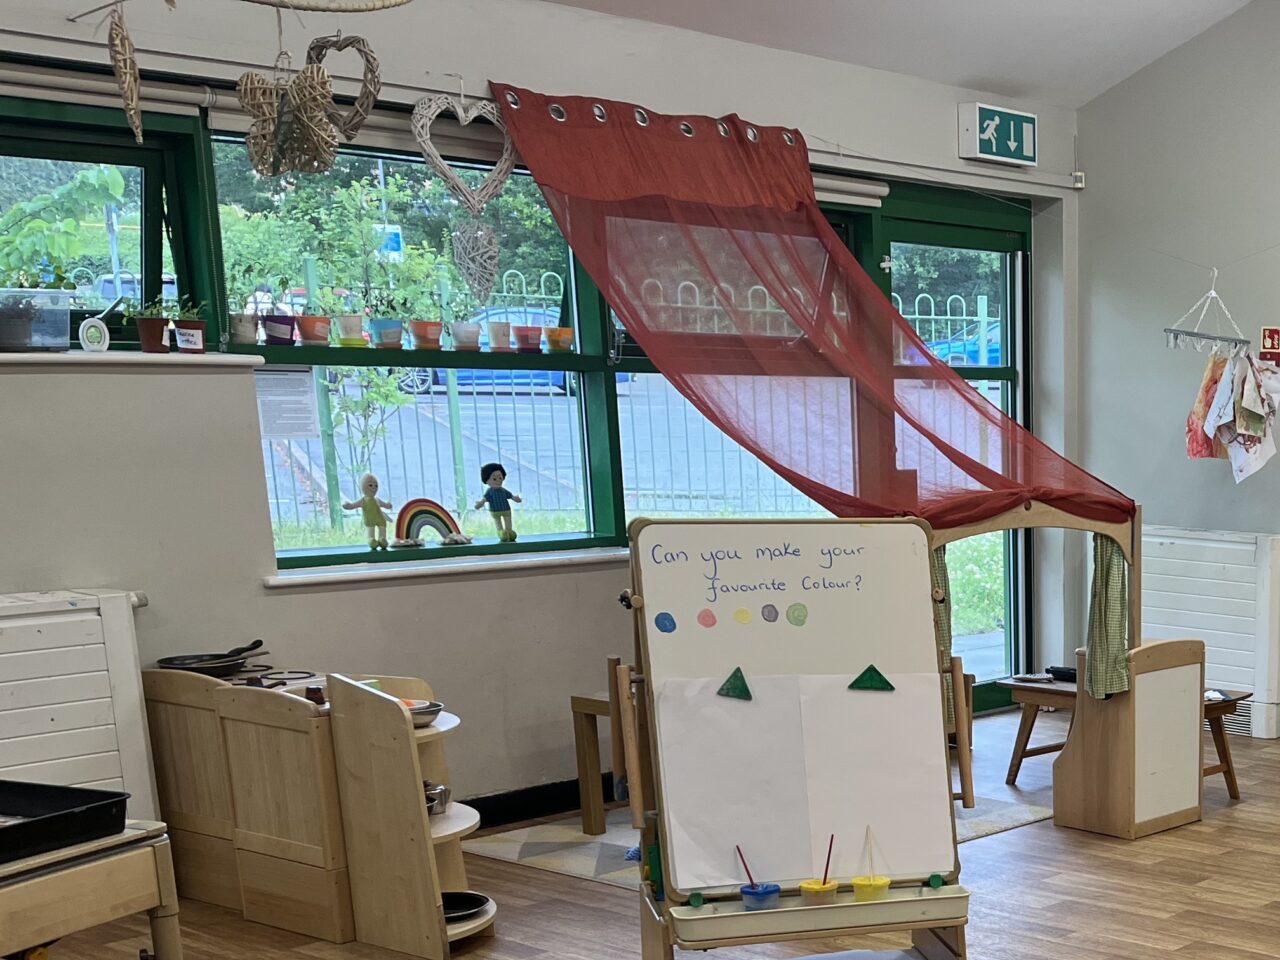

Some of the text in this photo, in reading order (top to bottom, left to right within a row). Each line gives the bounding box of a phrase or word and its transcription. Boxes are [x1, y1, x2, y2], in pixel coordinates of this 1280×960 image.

[651, 542, 865, 579] Can you make your
[706, 574, 863, 602] favourite Colour?
